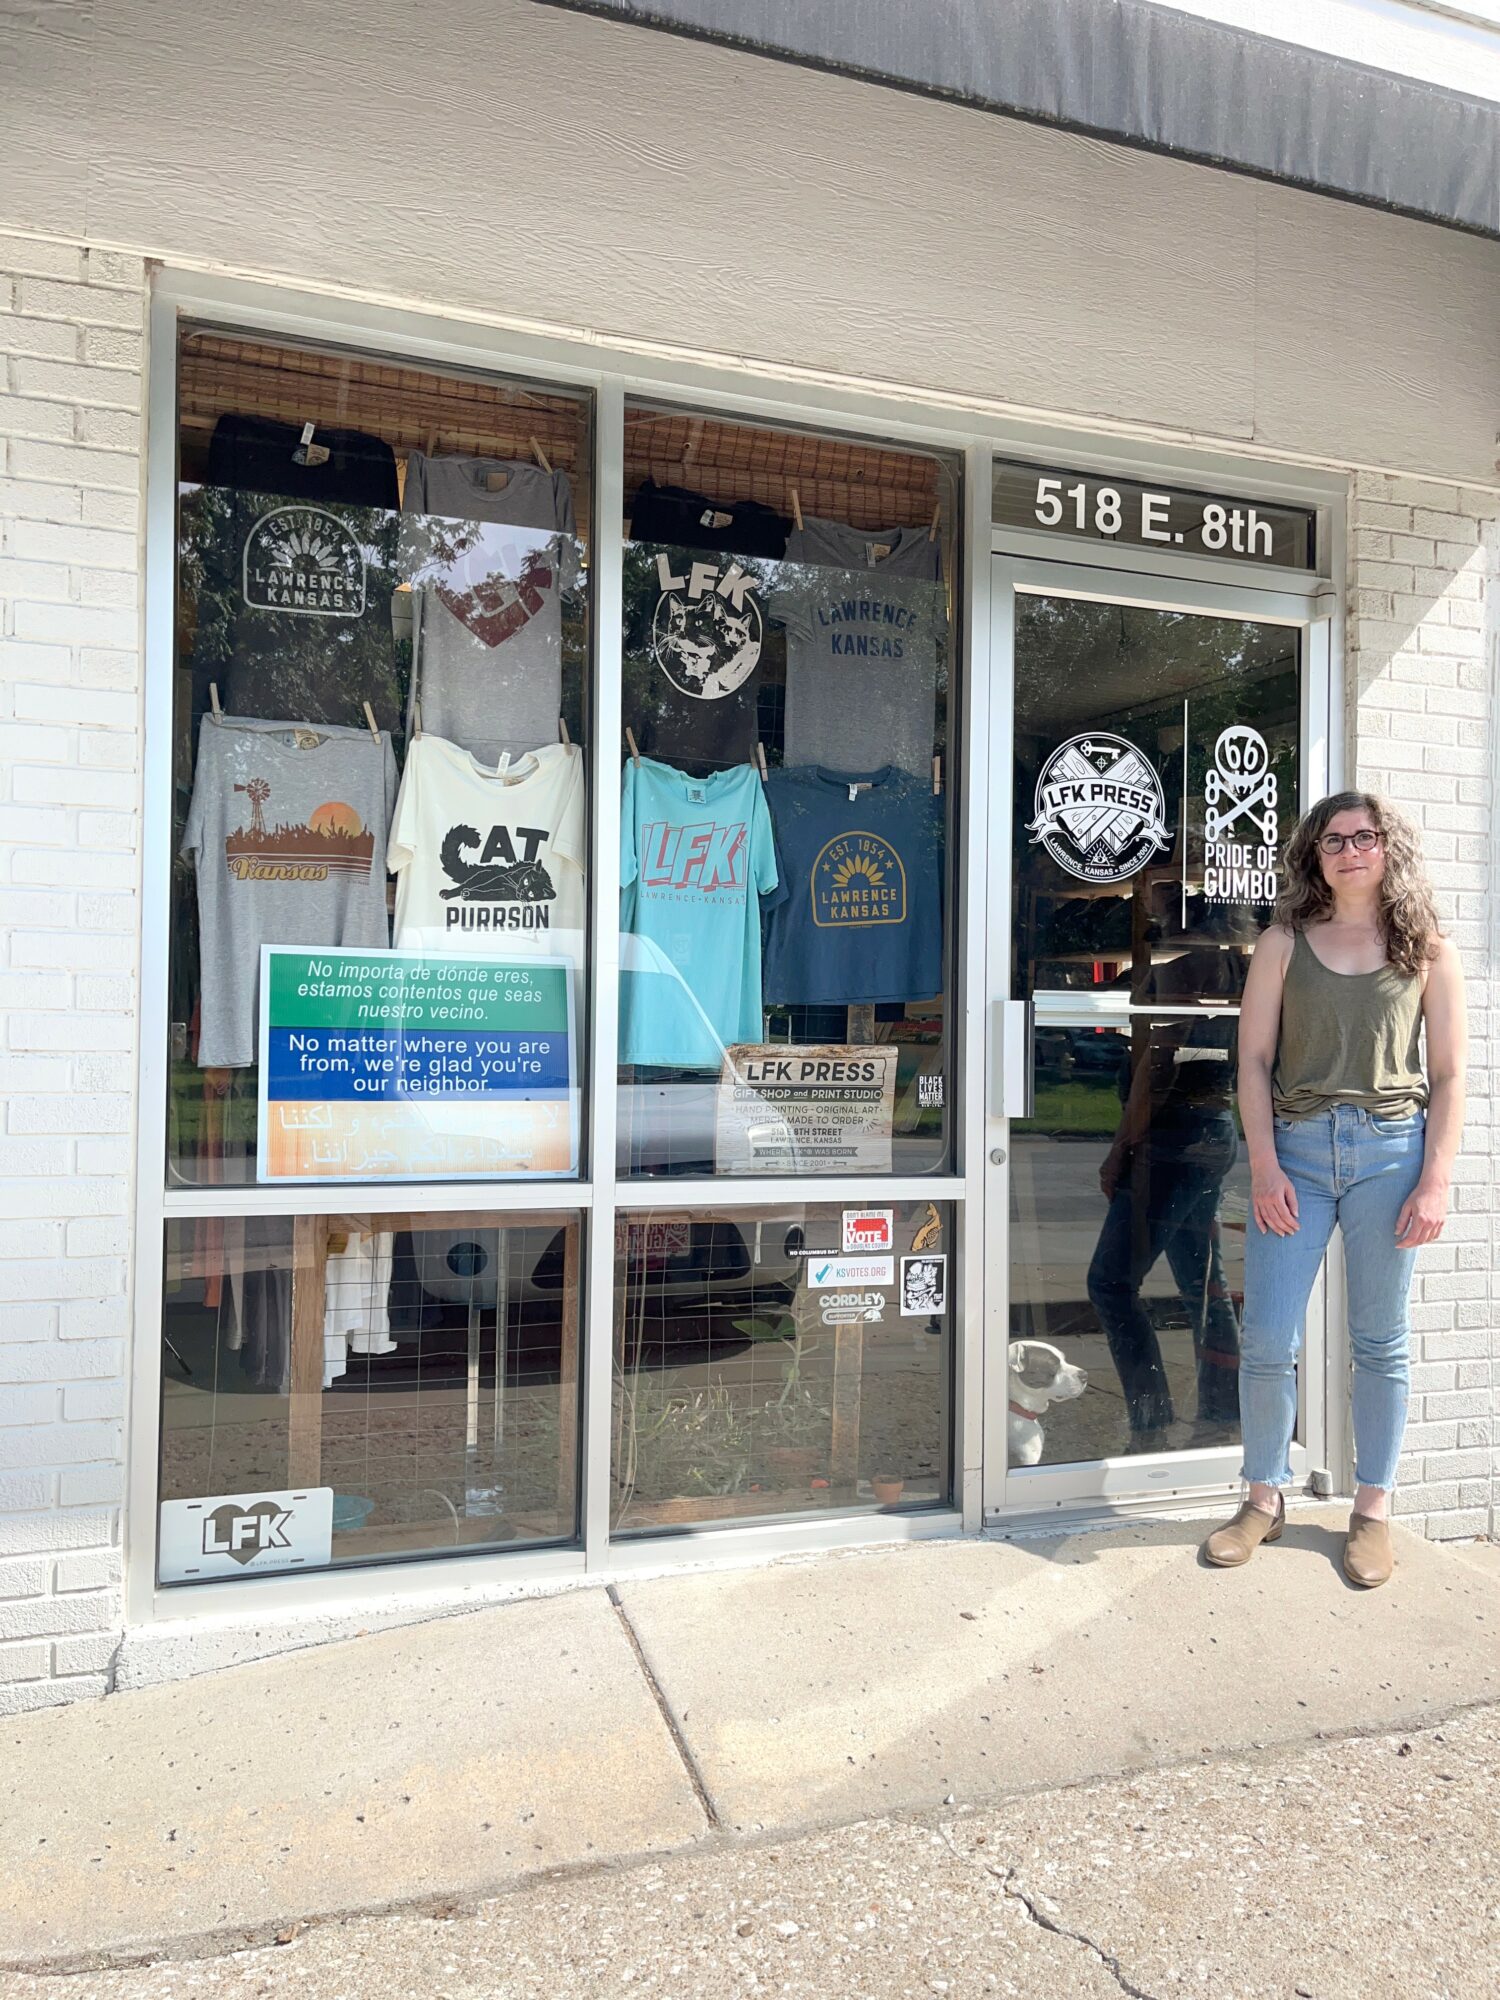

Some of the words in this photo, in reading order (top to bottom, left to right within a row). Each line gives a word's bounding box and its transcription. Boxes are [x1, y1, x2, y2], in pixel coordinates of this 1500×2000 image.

[1035, 478, 1122, 535] 518
[1142, 492, 1184, 543] E.
[1201, 504, 1273, 556] 8th
[307, 515, 342, 542] 1854
[256, 568, 355, 590] LAWRENCE
[656, 553, 760, 613] LFK
[267, 588, 343, 607] KANSAS
[818, 600, 917, 634] LAWRENCE
[831, 634, 904, 658] KANSAS
[1047, 784, 1085, 808] LFK
[1091, 783, 1153, 815] PRESS
[440, 824, 549, 870] CAT
[642, 822, 747, 890] LFK
[829, 841, 853, 861] EST.
[858, 839, 886, 860] 1854
[1050, 838, 1083, 873] LAWRENCE,
[1085, 866, 1114, 876] KANSAS
[1119, 857, 1139, 872] SINCE
[1137, 842, 1150, 860] 2001
[1205, 843, 1252, 868] PRIDE
[1257, 846, 1278, 870] OF
[231, 856, 329, 880] Kansas
[1205, 867, 1277, 900] GUMBO
[822, 888, 897, 904] LAWRENCE
[446, 904, 549, 932] PURRSON
[831, 904, 889, 919] KANSAS
[308, 960, 332, 978] No
[338, 962, 404, 982] importa
[410, 965, 431, 980] de
[437, 965, 488, 982] dónde
[494, 971, 533, 986] eres,
[297, 981, 372, 998] estamos
[379, 984, 462, 1000] contentos
[468, 989, 498, 1004] que
[504, 990, 542, 1003] seas
[358, 1003, 423, 1019] nuestro
[430, 1004, 488, 1020] vecino.
[289, 1034, 319, 1052] No
[328, 1036, 397, 1052] matter
[404, 1037, 467, 1053] where
[475, 1041, 511, 1057] you
[519, 1041, 550, 1054] are
[300, 1054, 355, 1074] from,
[365, 1056, 420, 1072] we're
[429, 1056, 473, 1076] glad
[480, 1057, 542, 1076] you're
[747, 1062, 792, 1081] LFK
[800, 1062, 875, 1081] PRESS
[353, 1078, 389, 1092] our
[397, 1075, 493, 1095] neighbor.
[919, 1076, 943, 1084] BLACK
[919, 1084, 943, 1092] LIVES
[734, 1088, 758, 1099] GIFT
[760, 1089, 791, 1099] SHOP
[794, 1090, 808, 1098] and
[811, 1089, 841, 1099] PRINT
[844, 1089, 883, 1099] STUDIO
[919, 1092, 943, 1101] MATTER
[736, 1106, 762, 1115] HAND
[766, 1105, 808, 1114] PRINTING
[816, 1105, 858, 1114] ORIGINAL
[861, 1105, 879, 1114] ART
[787, 1116, 813, 1124] MADE
[816, 1116, 829, 1124] TO
[832, 1116, 863, 1124] ORDER
[794, 1128, 811, 1136] 8TH
[812, 1128, 842, 1136] STREET
[847, 1220, 856, 1231] I
[847, 1230, 882, 1243] VOTE
[836, 1267, 886, 1278] KSVOTES.ORG
[819, 1292, 881, 1308] CORDLEY
[203, 1510, 294, 1554] LFK
